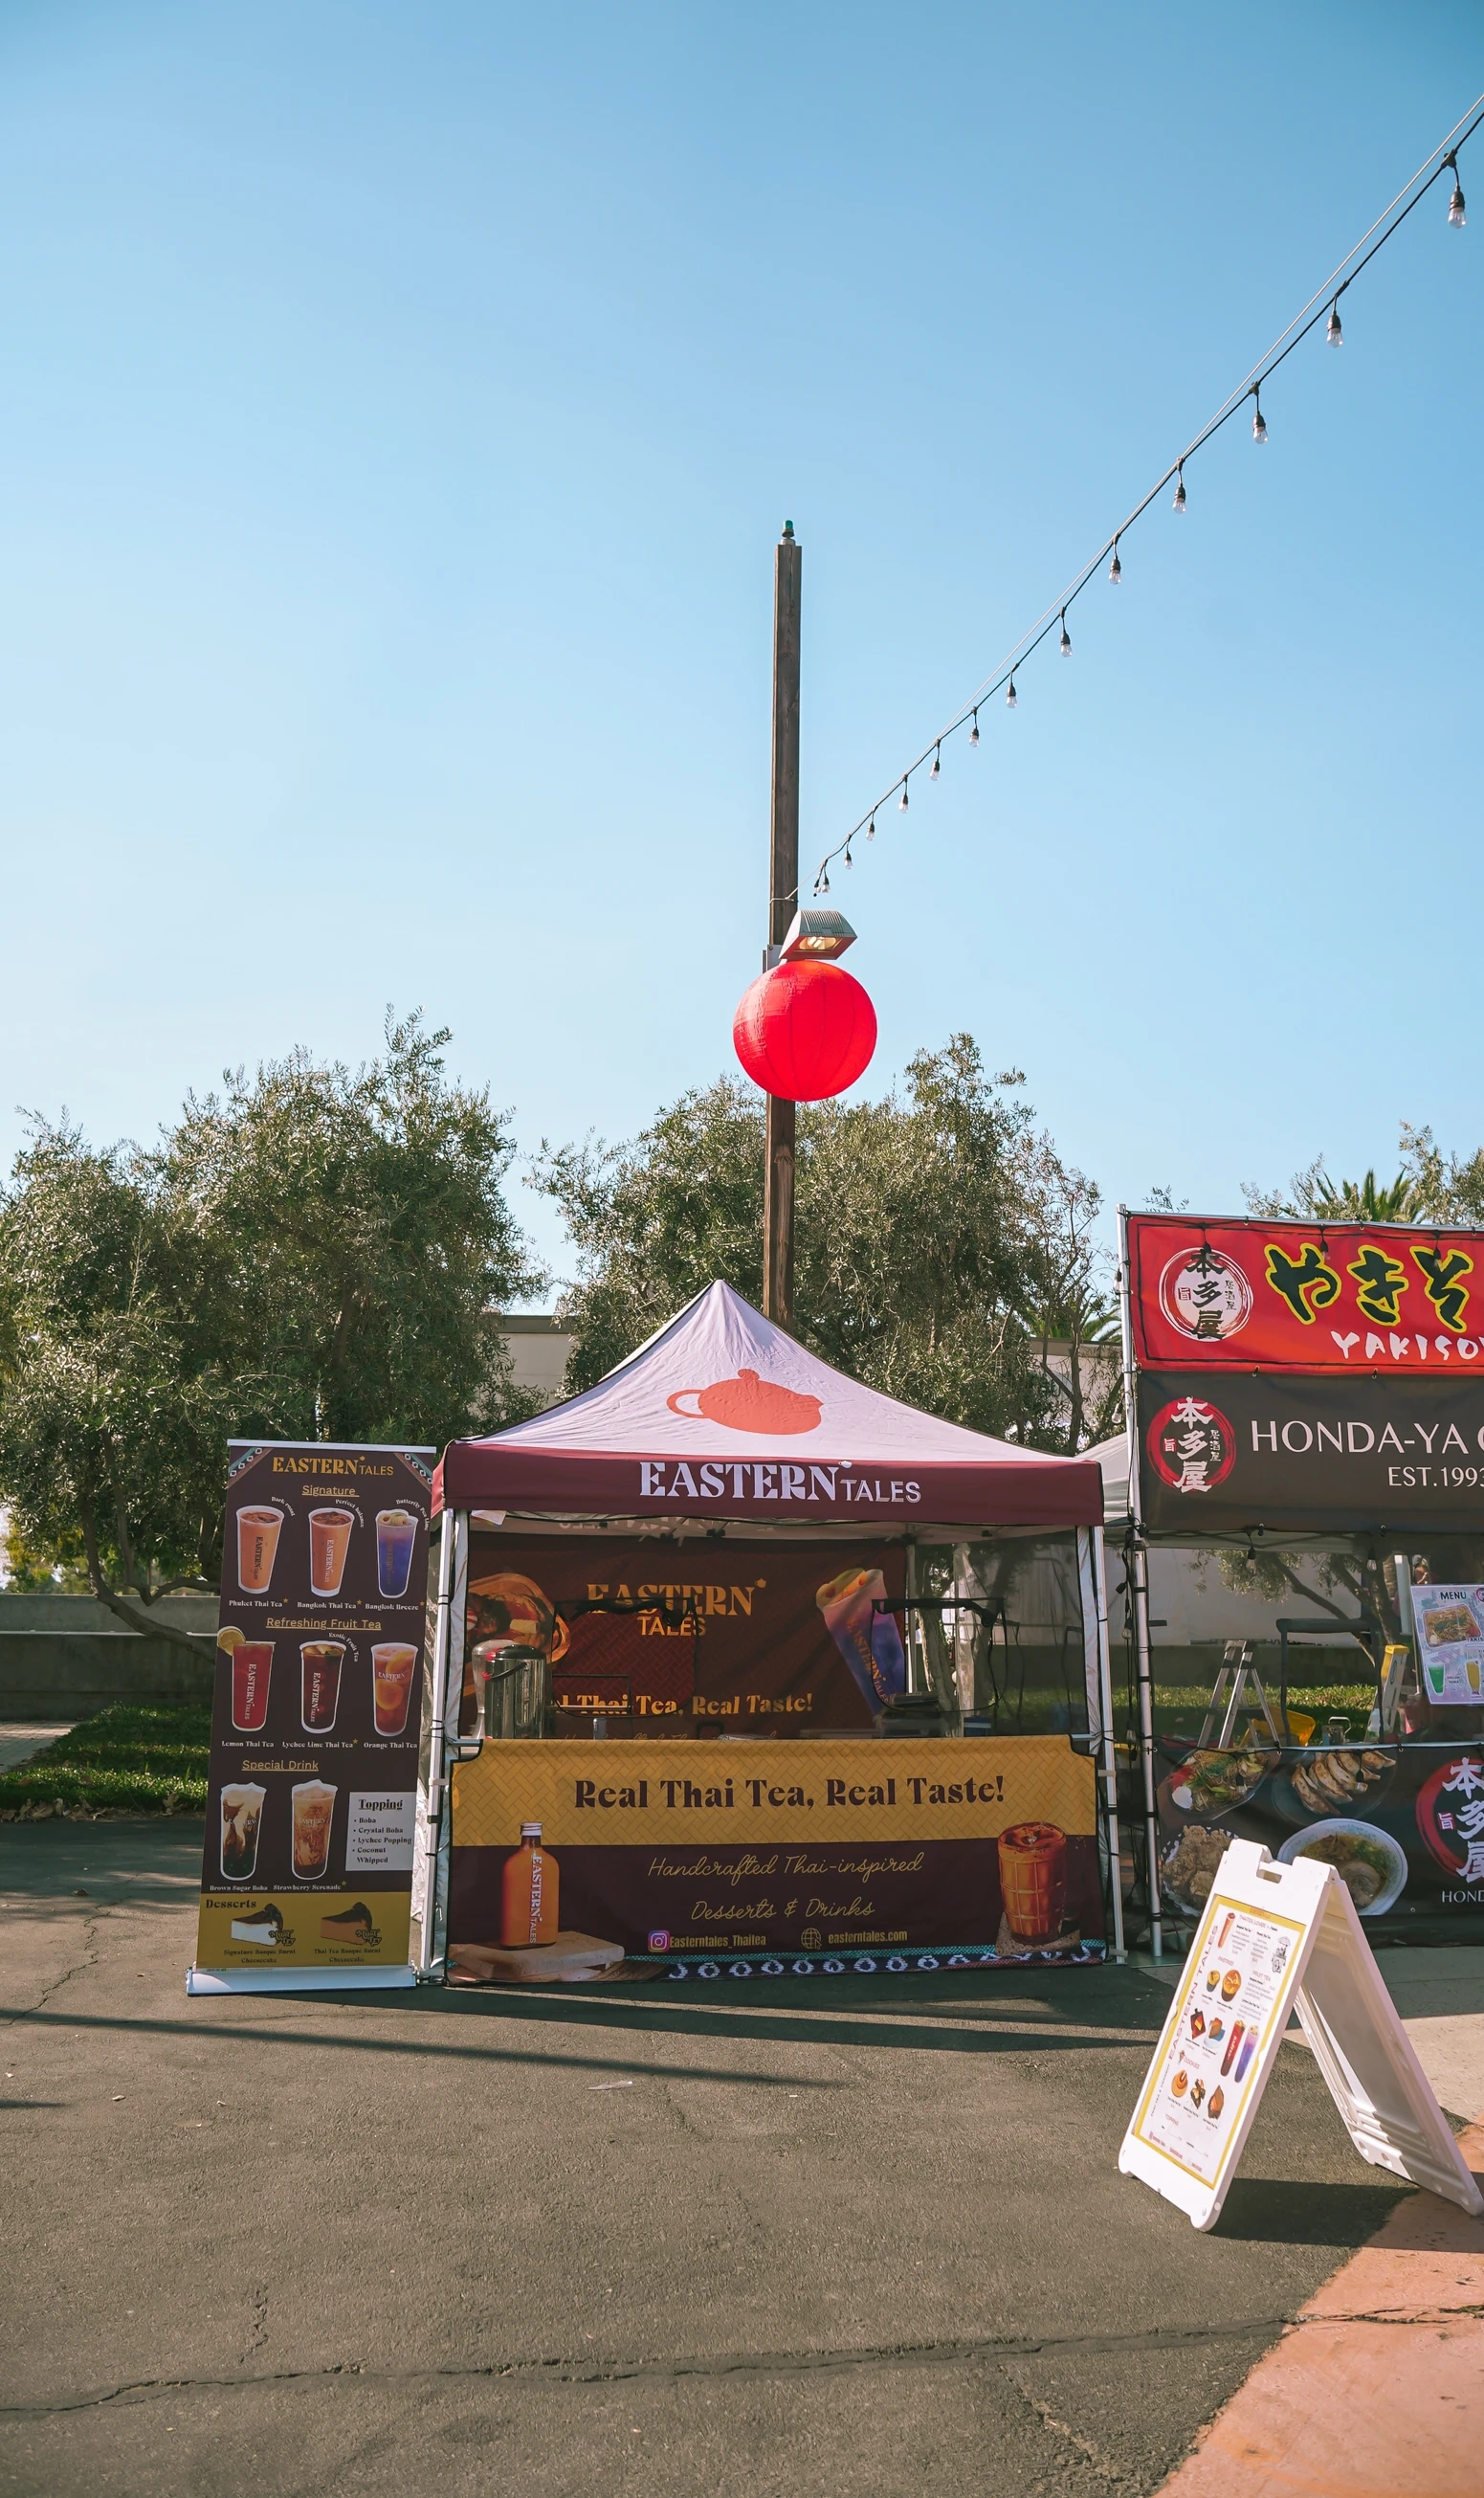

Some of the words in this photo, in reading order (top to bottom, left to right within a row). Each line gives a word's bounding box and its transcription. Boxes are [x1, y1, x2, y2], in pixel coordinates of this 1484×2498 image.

[1185, 1249, 1227, 1340] 本多屋
[1331, 1330, 1484, 1360] YAKISO
[1171, 1396, 1213, 1493] 本多屋
[1251, 1421, 1469, 1454] HONDA-YA
[273, 1457, 359, 1475] EASTERN
[359, 1465, 394, 1475] TALES
[302, 1484, 355, 1497] Signature
[639, 1461, 839, 1501] EASTERN
[840, 1479, 921, 1504] TALES
[335, 1499, 355, 1508] Perfect
[396, 1499, 421, 1508] Butterfly
[255, 1536, 263, 1568] EASTERN
[1440, 1592, 1467, 1600] MENU
[267, 1617, 327, 1630] Refreshing
[331, 1618, 357, 1629] Fruit
[362, 1619, 381, 1629] Tea
[637, 1616, 706, 1637] TALES
[328, 1632, 346, 1640] Exotic
[345, 1638, 357, 1652] Fruit
[246, 1663, 256, 1704] EASTERN
[312, 1672, 321, 1708] EASTERN
[635, 1695, 684, 1717] Tea,
[692, 1696, 740, 1715] Real
[747, 1692, 812, 1714] Taste!
[242, 1759, 284, 1772] Special
[289, 1760, 319, 1770] Drink
[575, 1779, 648, 1808] Real
[660, 1778, 735, 1808] Thai
[746, 1779, 814, 1810] Tea,
[826, 1778, 897, 1806] Real
[907, 1775, 1004, 1805] Taste!
[359, 1799, 403, 1811] Topping
[648, 1854, 778, 1885] Handcrafted
[785, 1852, 924, 1883] Thai-inspired
[531, 1857, 543, 1917] EASTERN
[206, 1899, 256, 1908] Desserts
[691, 1898, 777, 1920] Desserts
[785, 1898, 798, 1918] &
[806, 1897, 875, 1918] Drinks
[670, 1934, 766, 1949] Easterntales_Thaitea
[829, 1930, 907, 1944] easterntales.com
[1169, 1982, 1198, 2060] EASTERN
[1197, 1925, 1219, 1978] TALES
